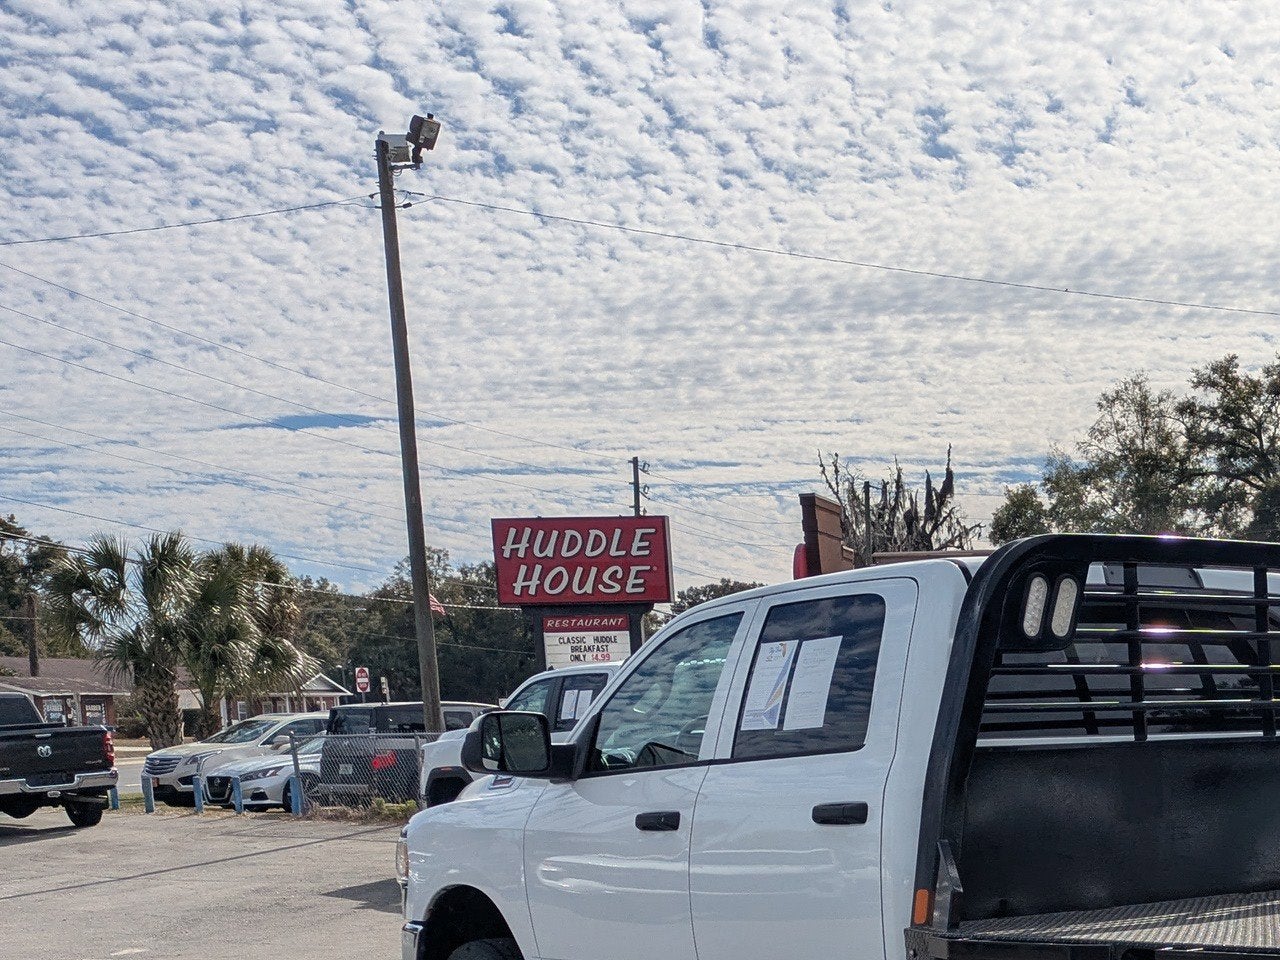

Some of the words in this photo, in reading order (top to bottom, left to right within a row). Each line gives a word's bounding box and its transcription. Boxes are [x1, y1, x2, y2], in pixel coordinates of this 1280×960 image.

[502, 527, 656, 558] HUDDLE
[513, 564, 651, 595] HOUSE
[547, 618, 624, 627] RESTAURANT
[558, 636, 587, 645] CLASSIC
[593, 635, 618, 644] HUDDLE
[570, 645, 609, 653] BREAKFAST
[569, 654, 587, 662] ONLY
[591, 653, 611, 661] $4.99
